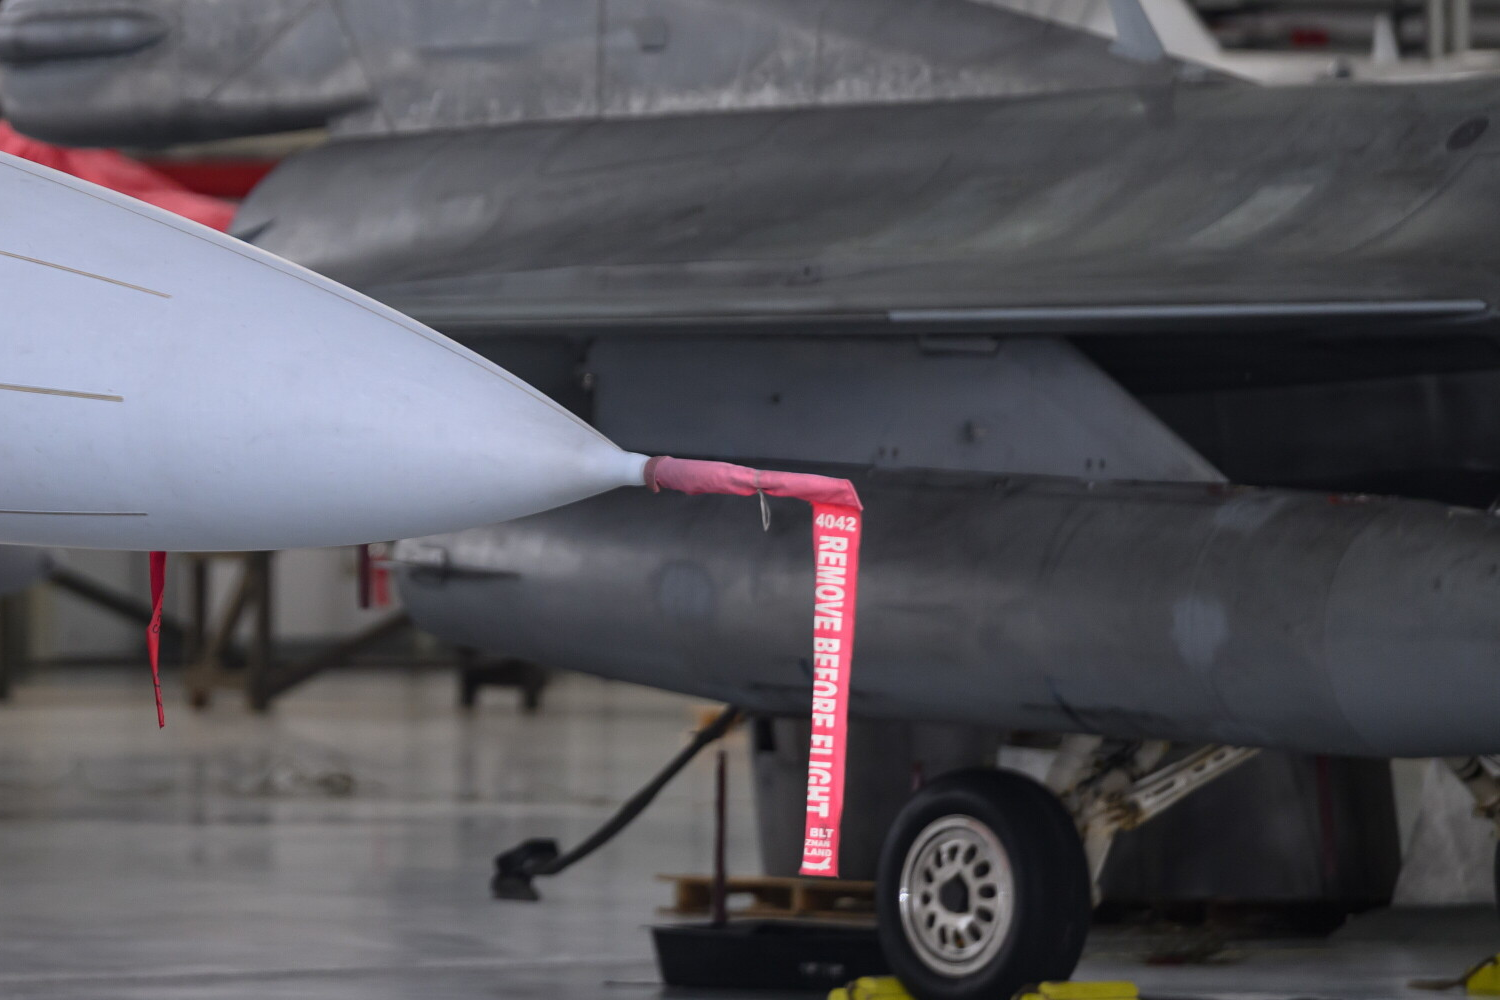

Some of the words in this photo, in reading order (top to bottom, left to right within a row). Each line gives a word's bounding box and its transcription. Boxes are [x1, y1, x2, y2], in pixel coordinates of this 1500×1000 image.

[815, 513, 857, 532] 4042
[813, 535, 849, 632] REMOVE
[811, 636, 841, 728] BEFORE
